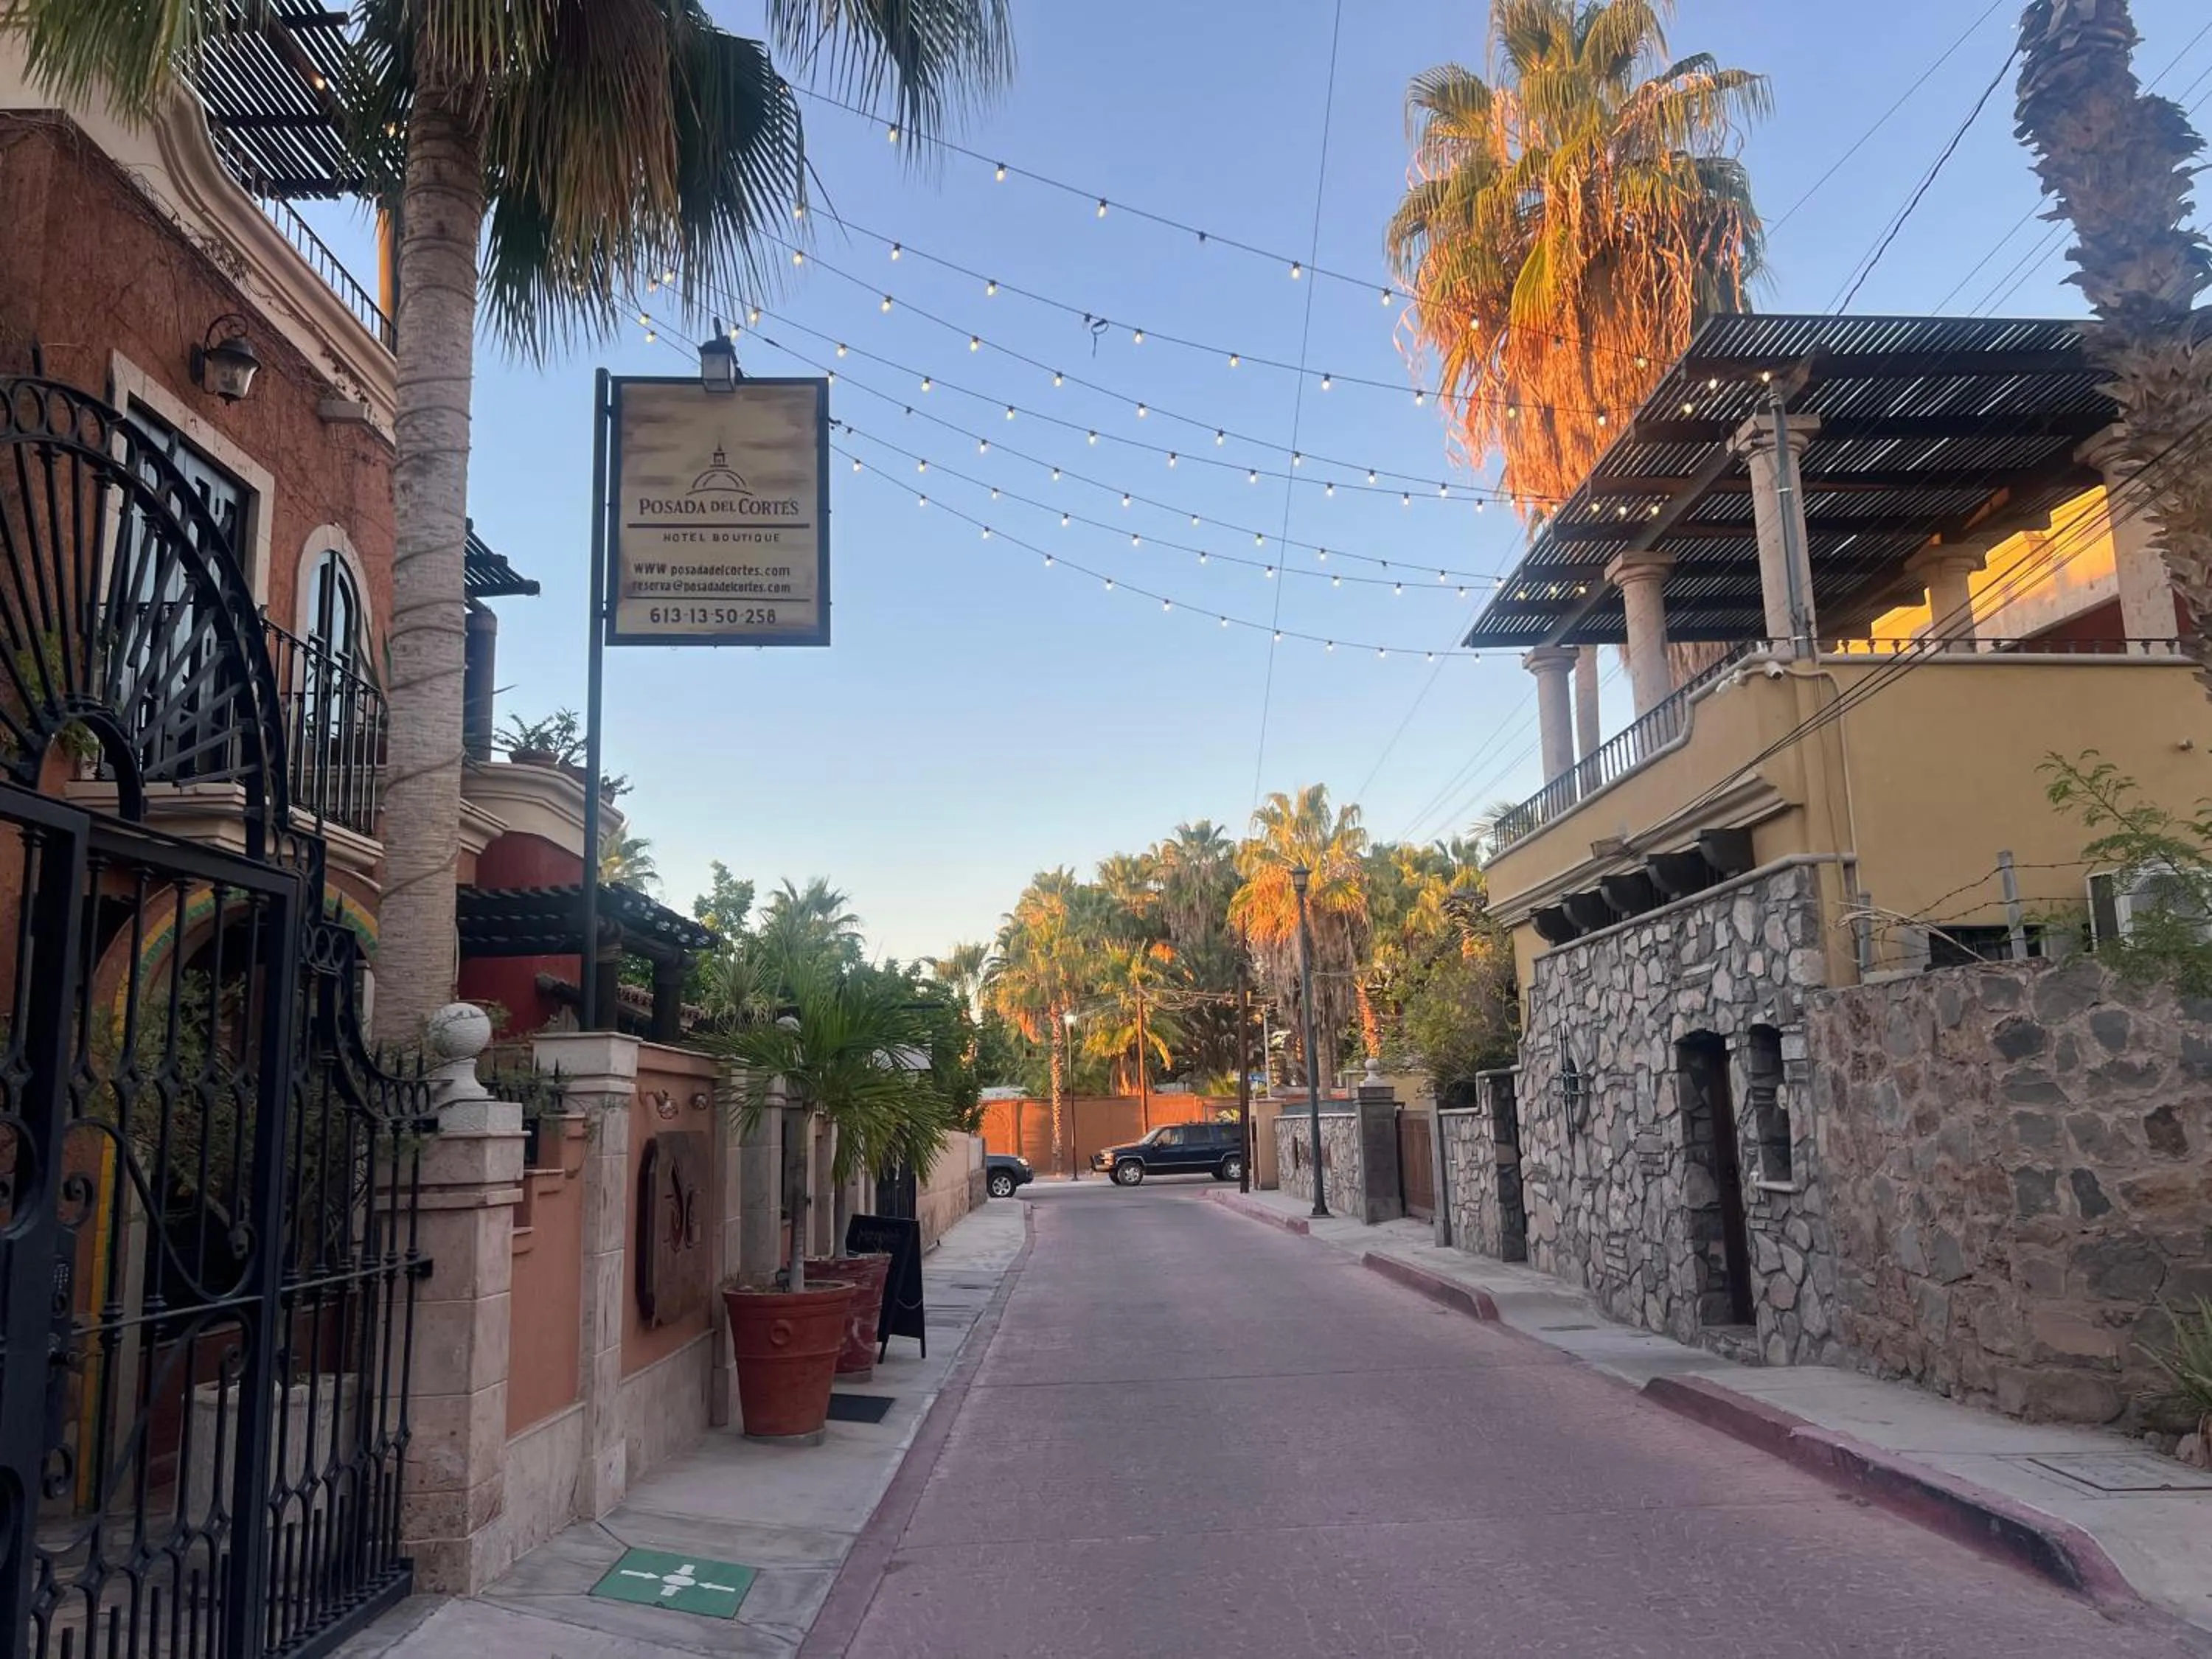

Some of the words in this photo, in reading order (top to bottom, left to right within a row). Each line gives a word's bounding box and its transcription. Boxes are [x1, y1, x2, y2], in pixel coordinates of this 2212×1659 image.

[639, 498, 706, 515] POSADA
[710, 501, 736, 513] DEL
[663, 533, 706, 542] HOTEL
[712, 533, 779, 542] BOUTIQUE
